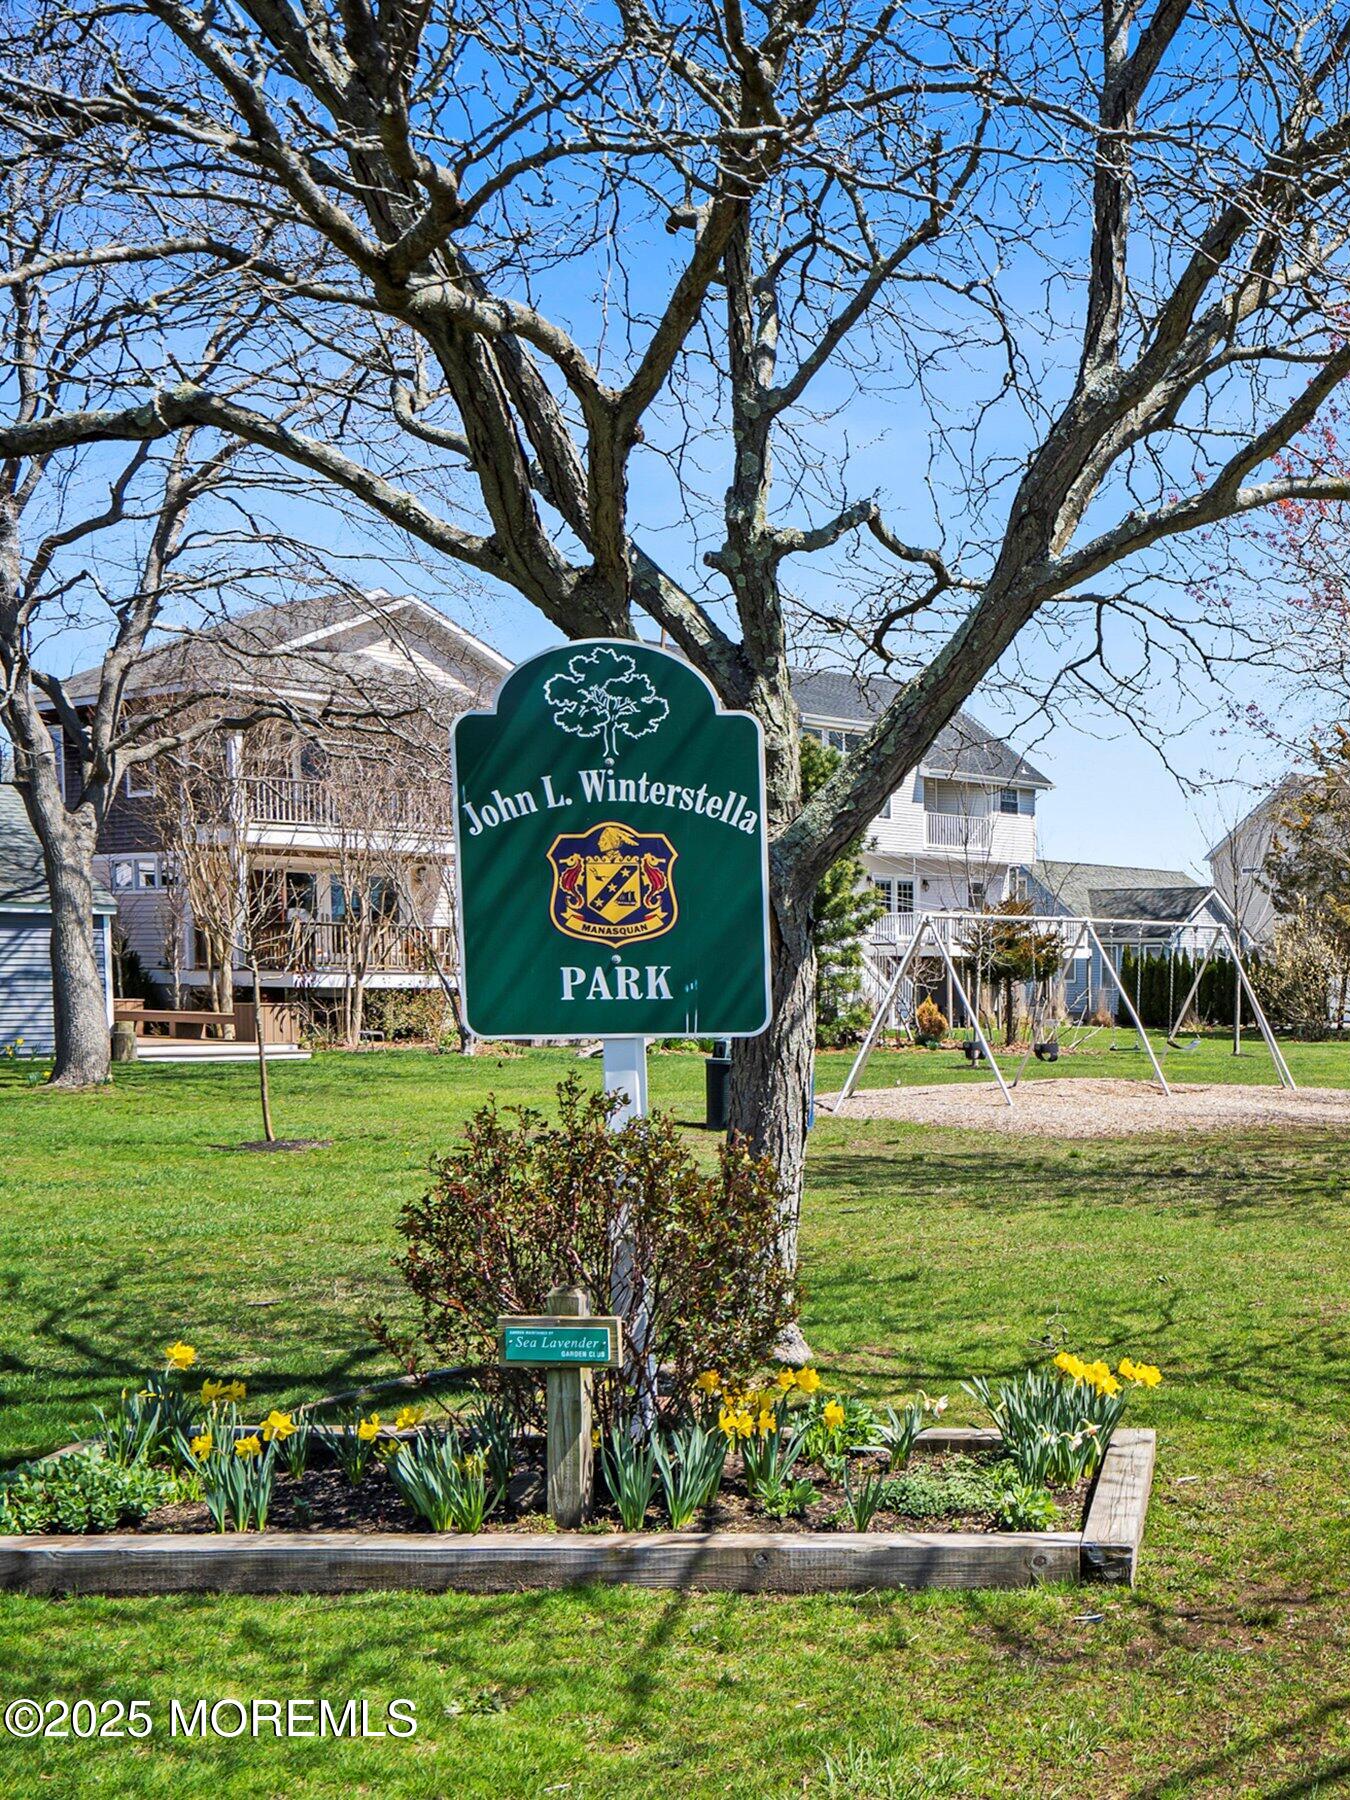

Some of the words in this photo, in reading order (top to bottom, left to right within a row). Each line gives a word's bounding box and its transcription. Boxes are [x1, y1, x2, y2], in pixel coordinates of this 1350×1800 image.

[462, 790, 538, 836] John
[541, 775, 573, 809] L.
[578, 769, 759, 834] Winterstella
[582, 923, 649, 935] MANASQUAN
[560, 966, 673, 1000] PARK
[515, 1336, 537, 1348] Sea
[541, 1336, 599, 1348] Lavender
